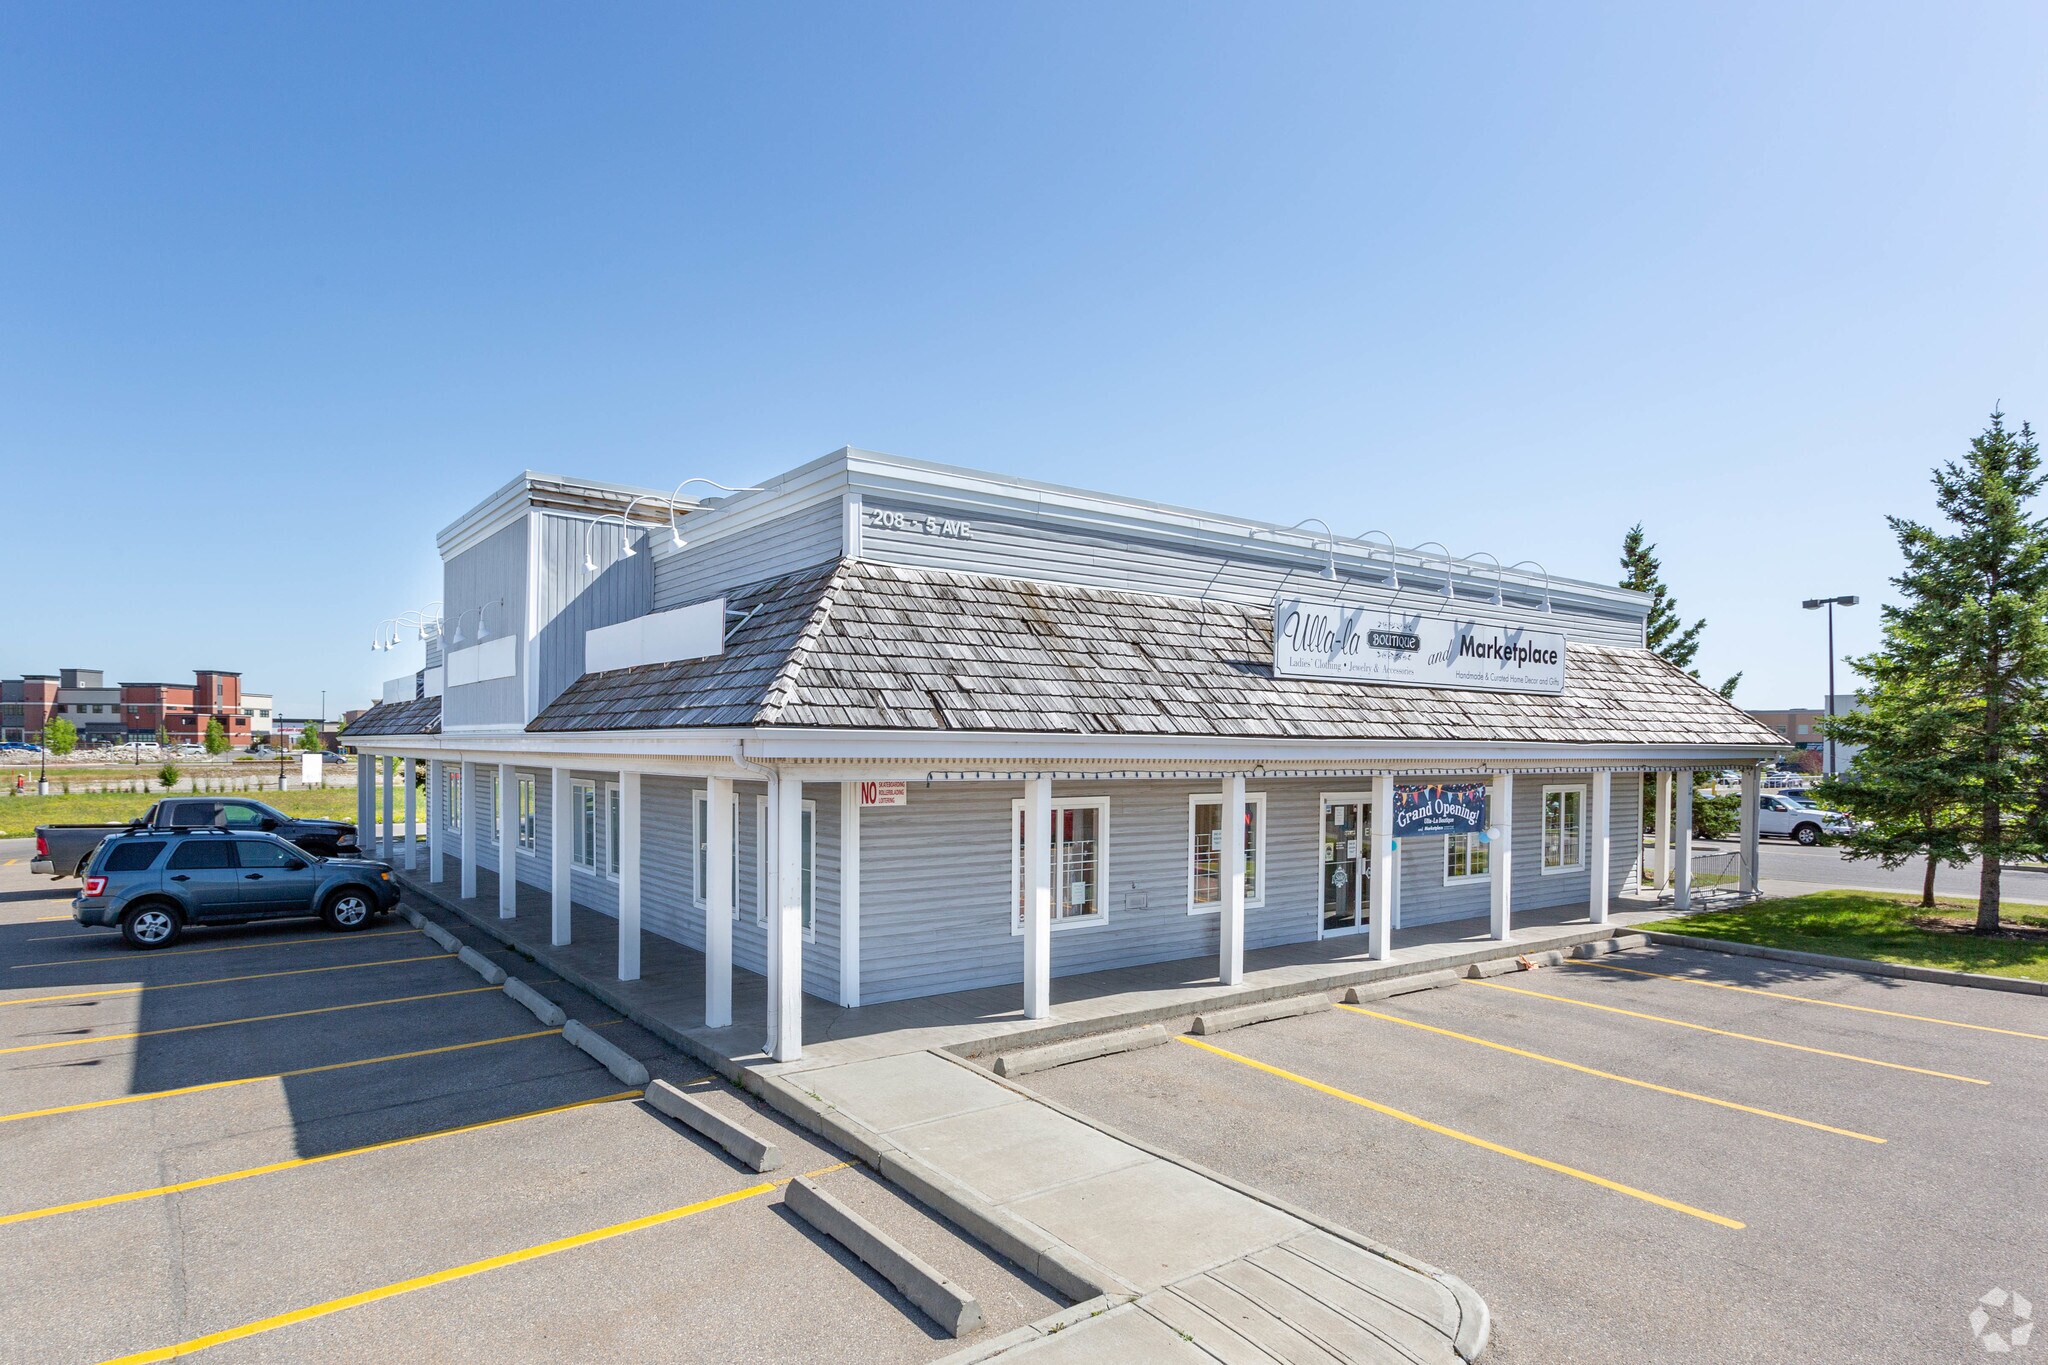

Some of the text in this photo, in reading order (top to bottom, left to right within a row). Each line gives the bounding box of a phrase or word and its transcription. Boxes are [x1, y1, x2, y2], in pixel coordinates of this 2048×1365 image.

[873, 509, 904, 528] 208
[926, 516, 936, 532] 5
[1284, 611, 1360, 656] Ulla-la
[1427, 639, 1452, 666] and
[1459, 634, 1558, 669] Marketplace
[1314, 658, 1341, 672] Clothing
[1348, 661, 1372, 673] Jewelry
[1373, 664, 1379, 673] &
[1382, 665, 1415, 676] Accessories
[1455, 670, 1484, 681] Handmade
[1490, 672, 1509, 683] Curated
[1510, 675, 1523, 683] Home
[1524, 675, 1538, 684] Decor
[1539, 677, 1548, 685] and
[861, 781, 877, 804] NO
[1398, 799, 1480, 827] Grand Opening!
